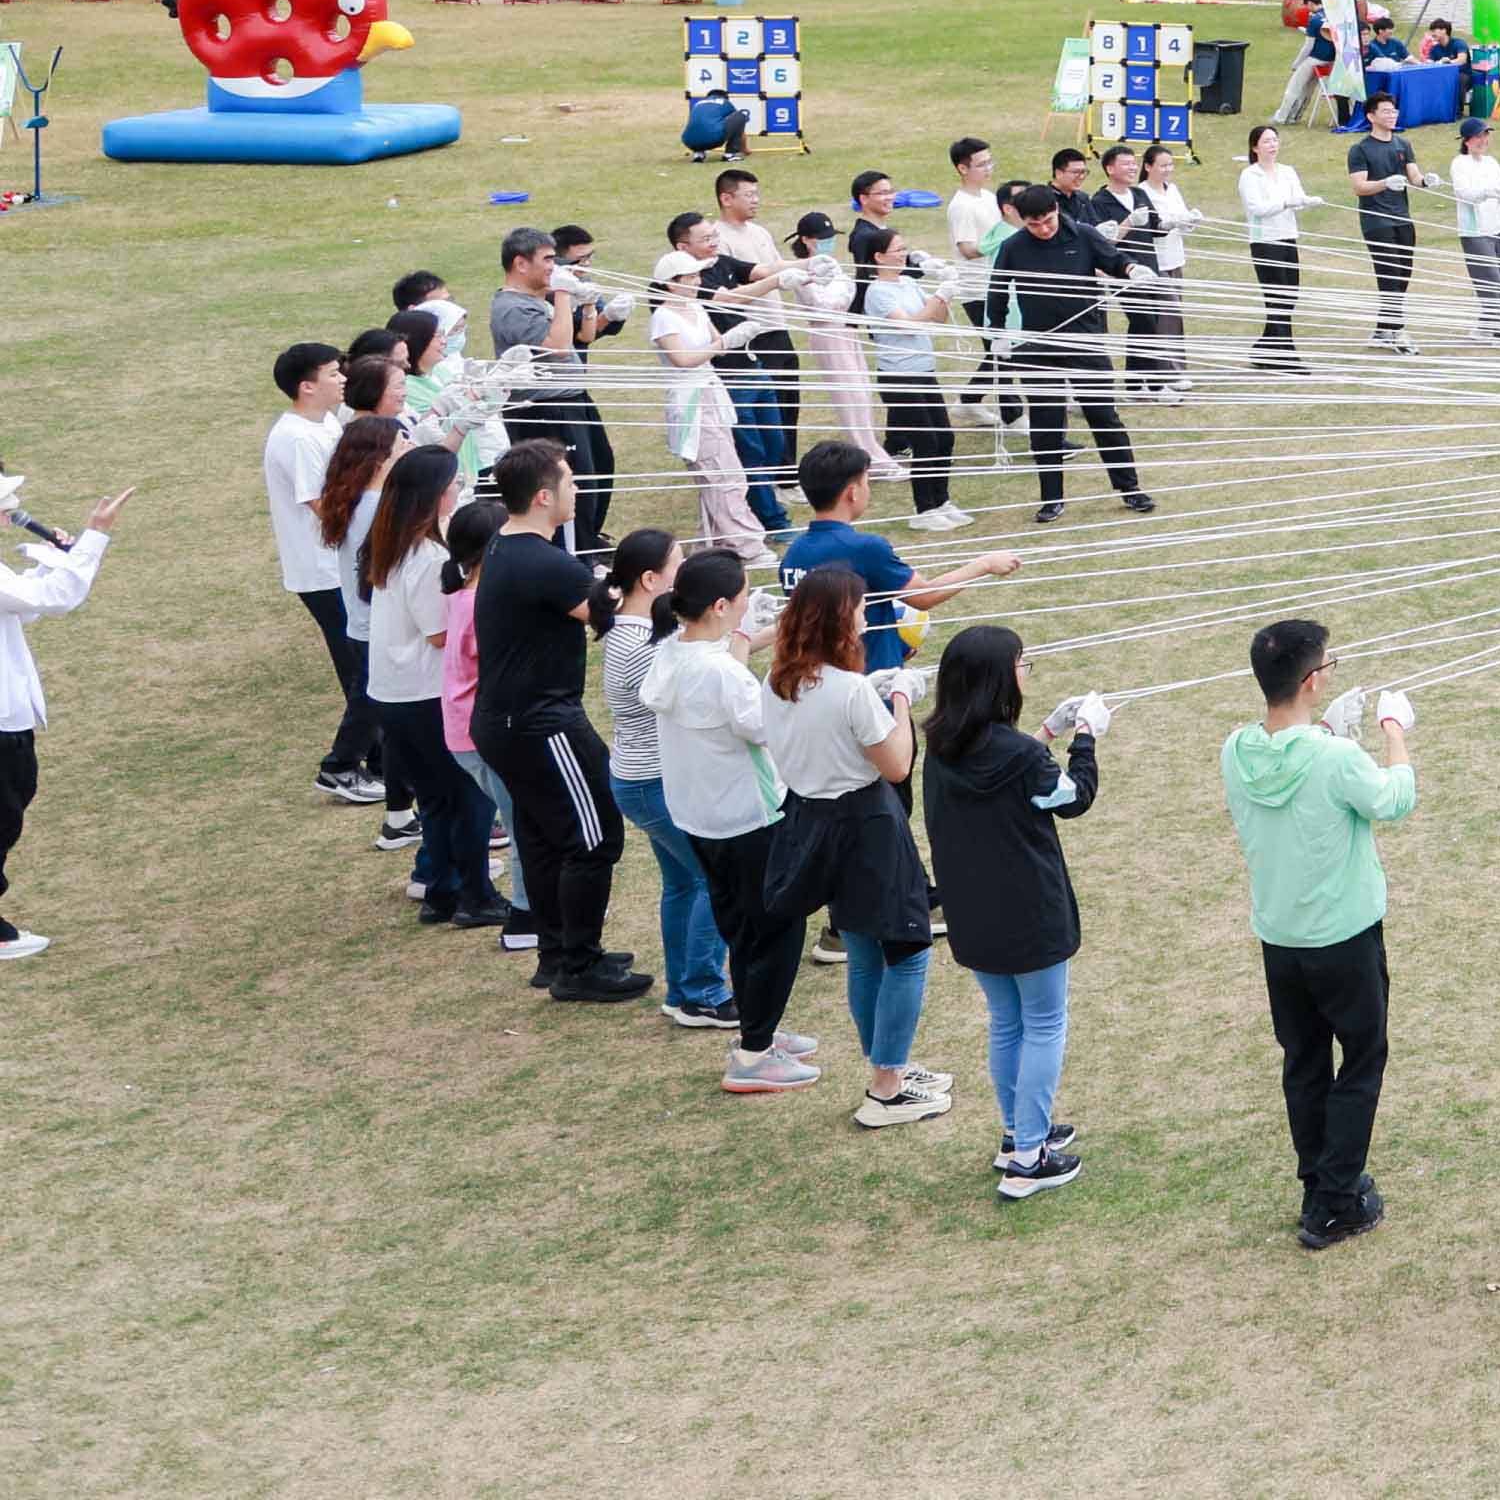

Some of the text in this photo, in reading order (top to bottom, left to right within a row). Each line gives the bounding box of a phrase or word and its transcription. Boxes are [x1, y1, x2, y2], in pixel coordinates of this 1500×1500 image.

[700, 29, 711, 45] 1
[737, 31, 749, 45] 2
[772, 29, 786, 45] 3
[1103, 35, 1114, 49] 8
[1137, 36, 1146, 53] 1
[1168, 39, 1180, 52] 4
[774, 68, 787, 83] 6
[775, 107, 789, 123] 9
[1134, 115, 1146, 130] 3
[1168, 116, 1180, 131] 7
